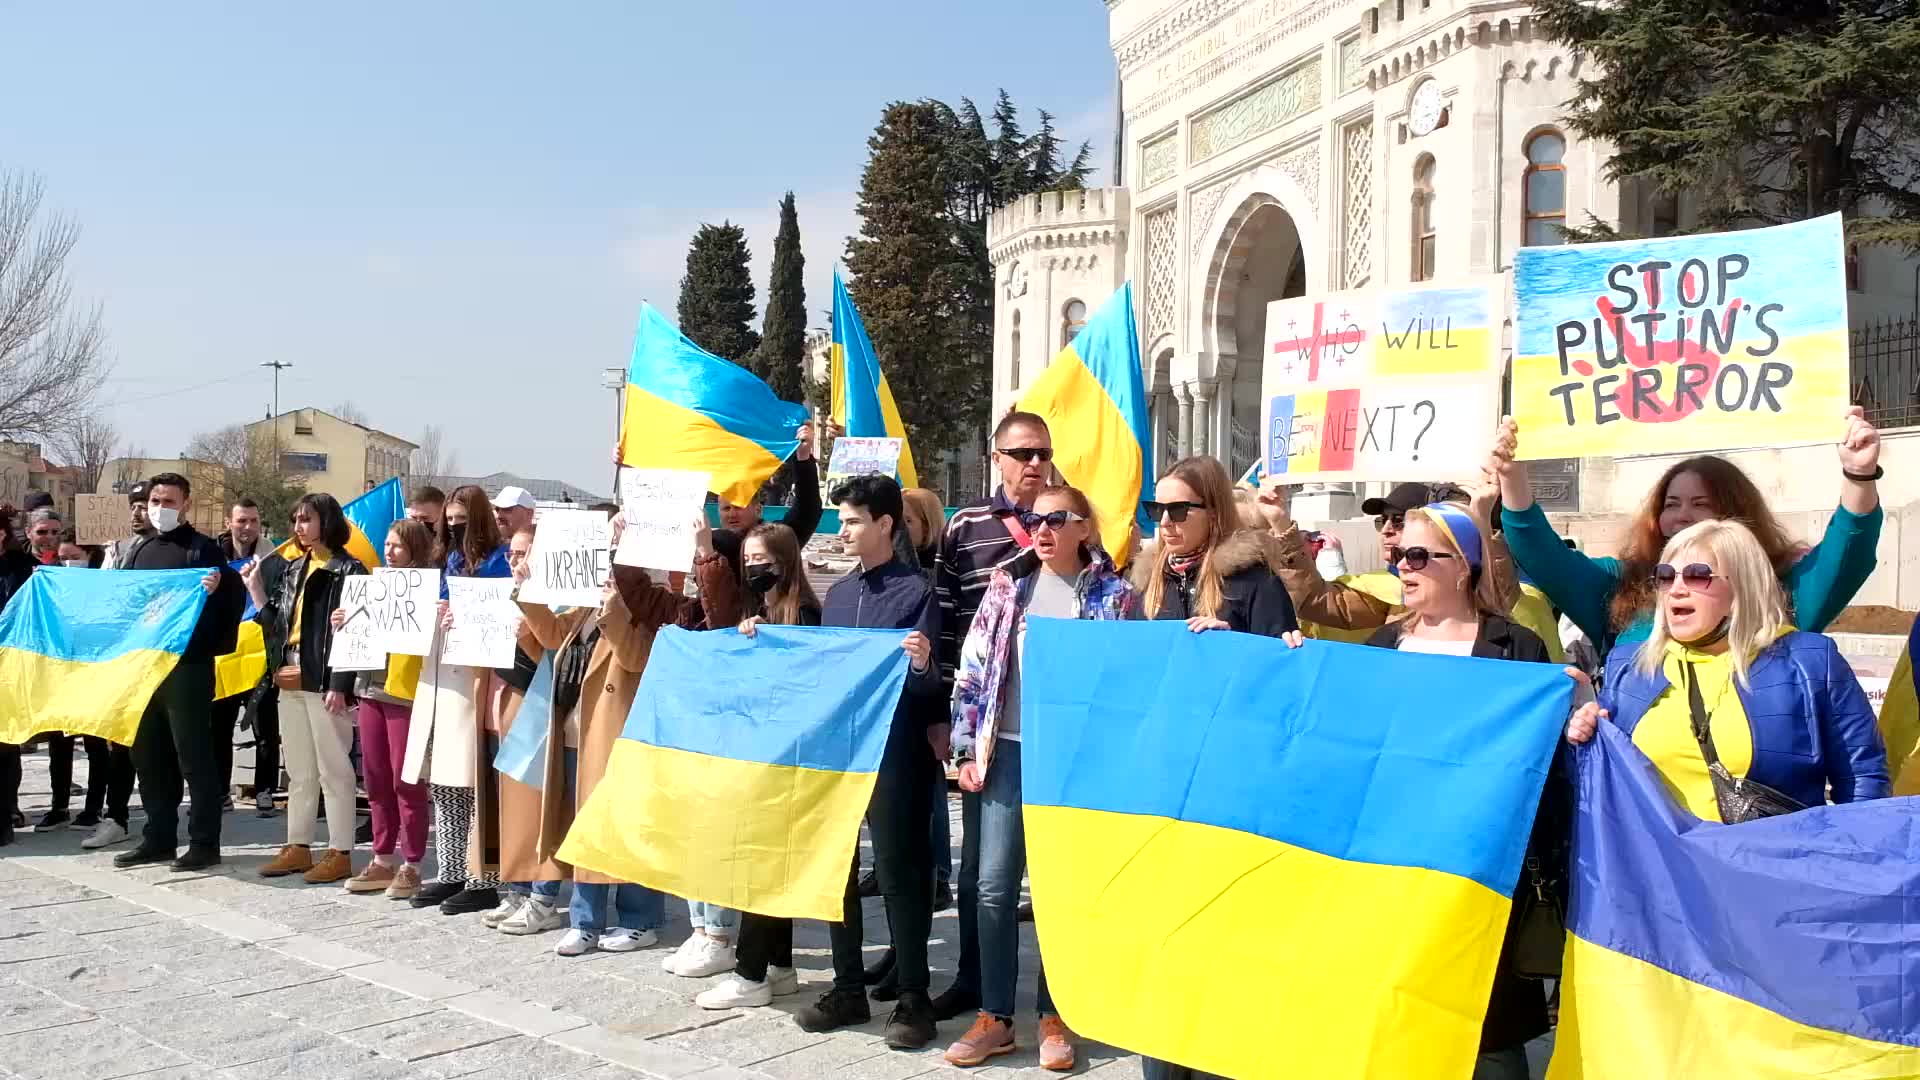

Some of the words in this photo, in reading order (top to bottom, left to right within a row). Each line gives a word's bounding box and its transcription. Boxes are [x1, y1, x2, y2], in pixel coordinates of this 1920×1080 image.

[1607, 253, 1750, 313] STOP
[1294, 323, 1361, 361] WHO
[1549, 362, 1793, 426] TERROR
[1271, 414, 1304, 460] BE
[1324, 399, 1436, 462] NEXT?
[374, 569, 423, 601] STOP
[372, 600, 422, 633] WAR
